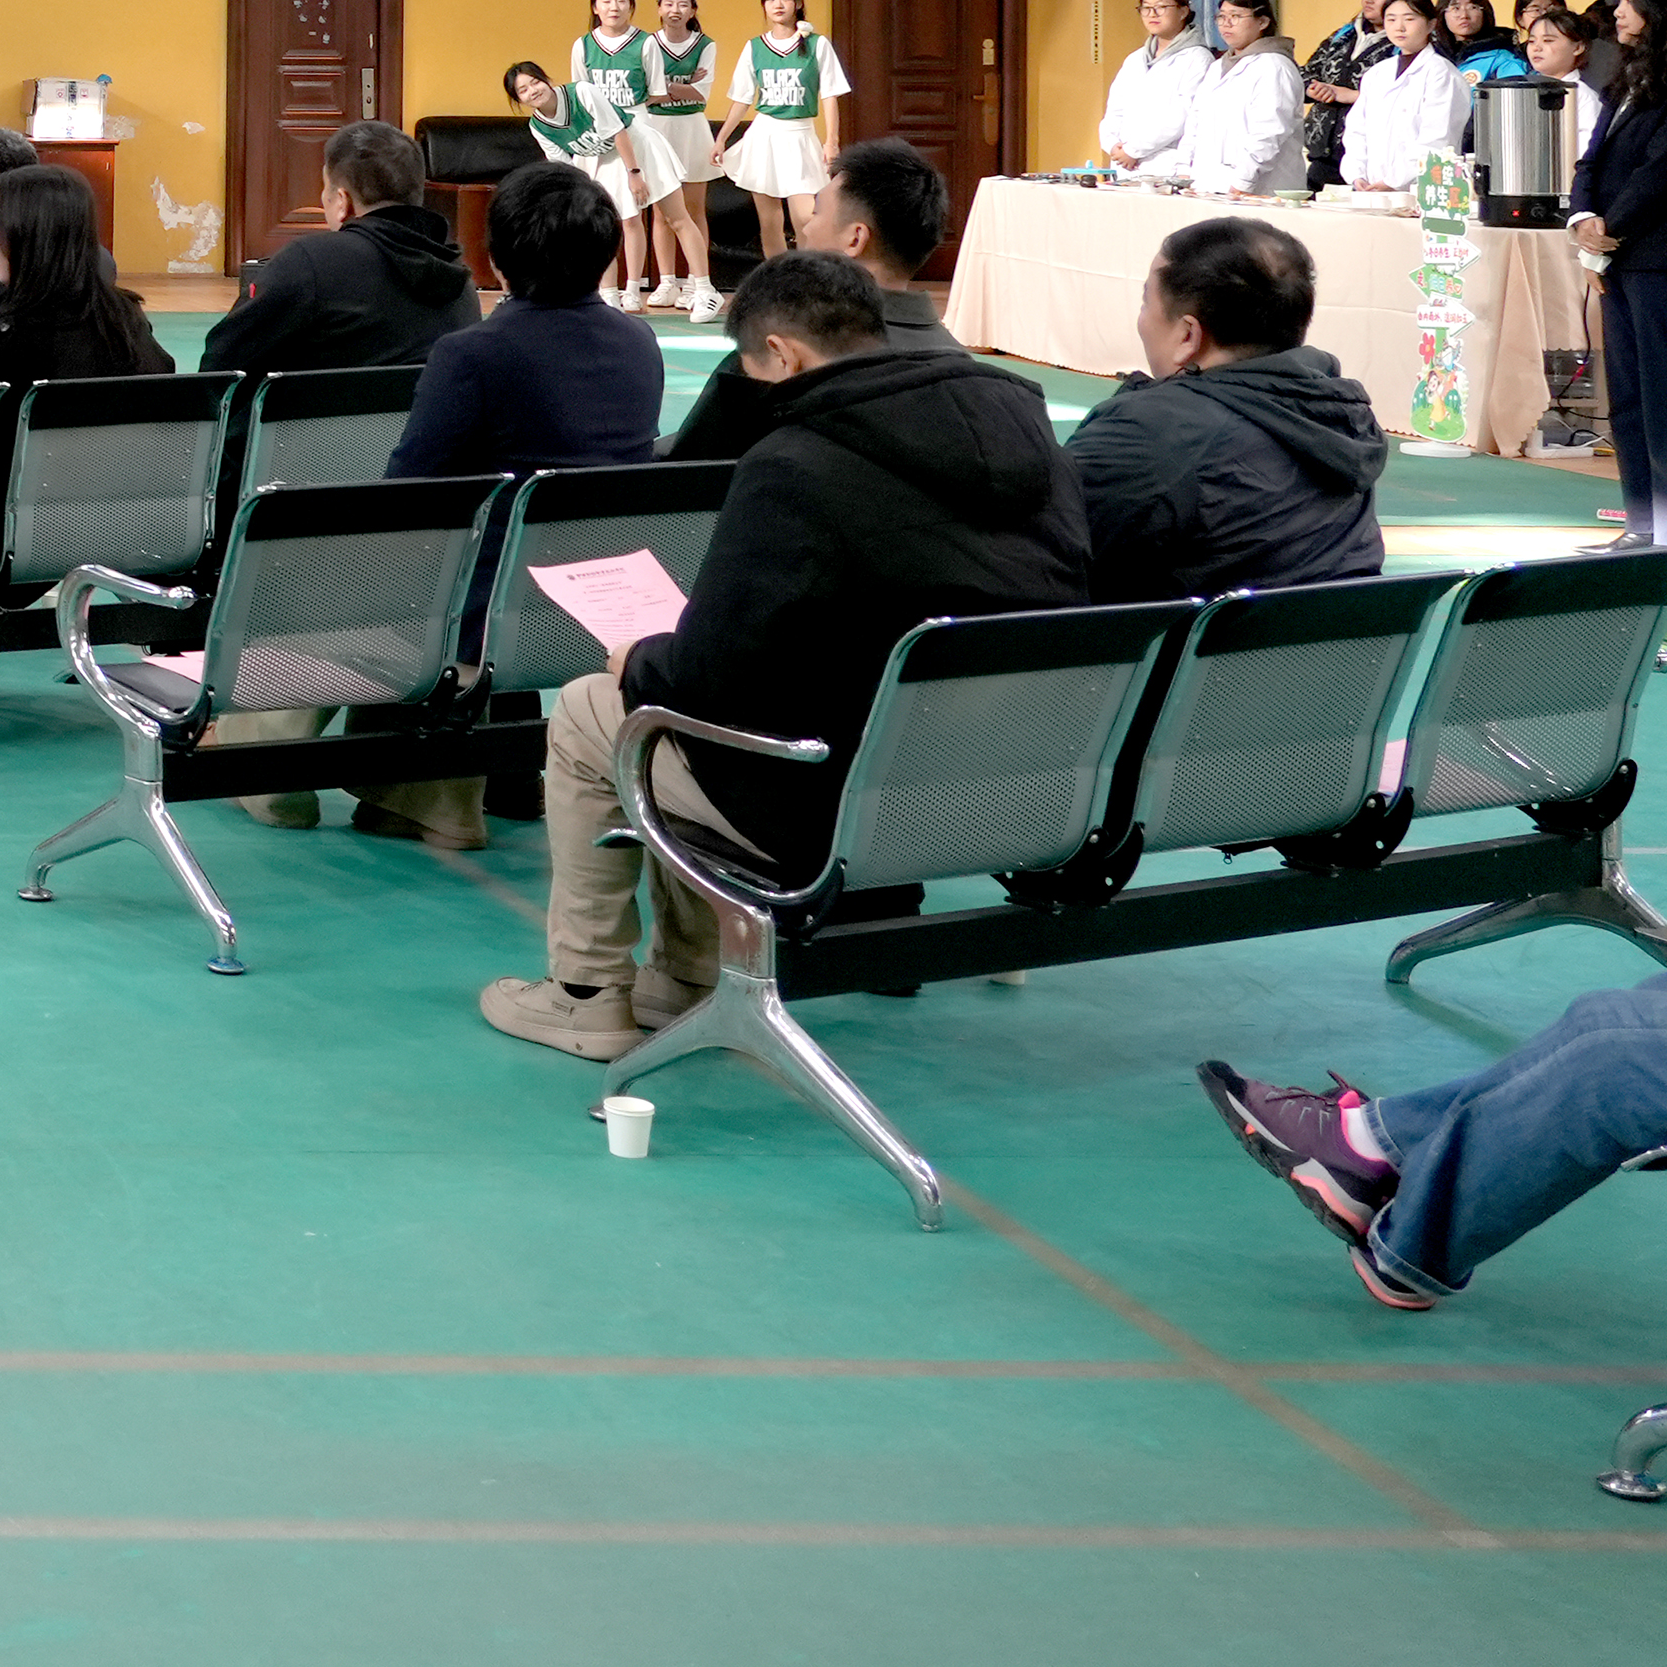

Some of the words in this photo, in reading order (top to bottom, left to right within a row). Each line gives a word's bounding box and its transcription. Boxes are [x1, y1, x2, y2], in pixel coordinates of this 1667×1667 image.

[592, 69, 630, 88] BLACK
[761, 68, 803, 88] BLACK
[600, 87, 634, 107] RROR
